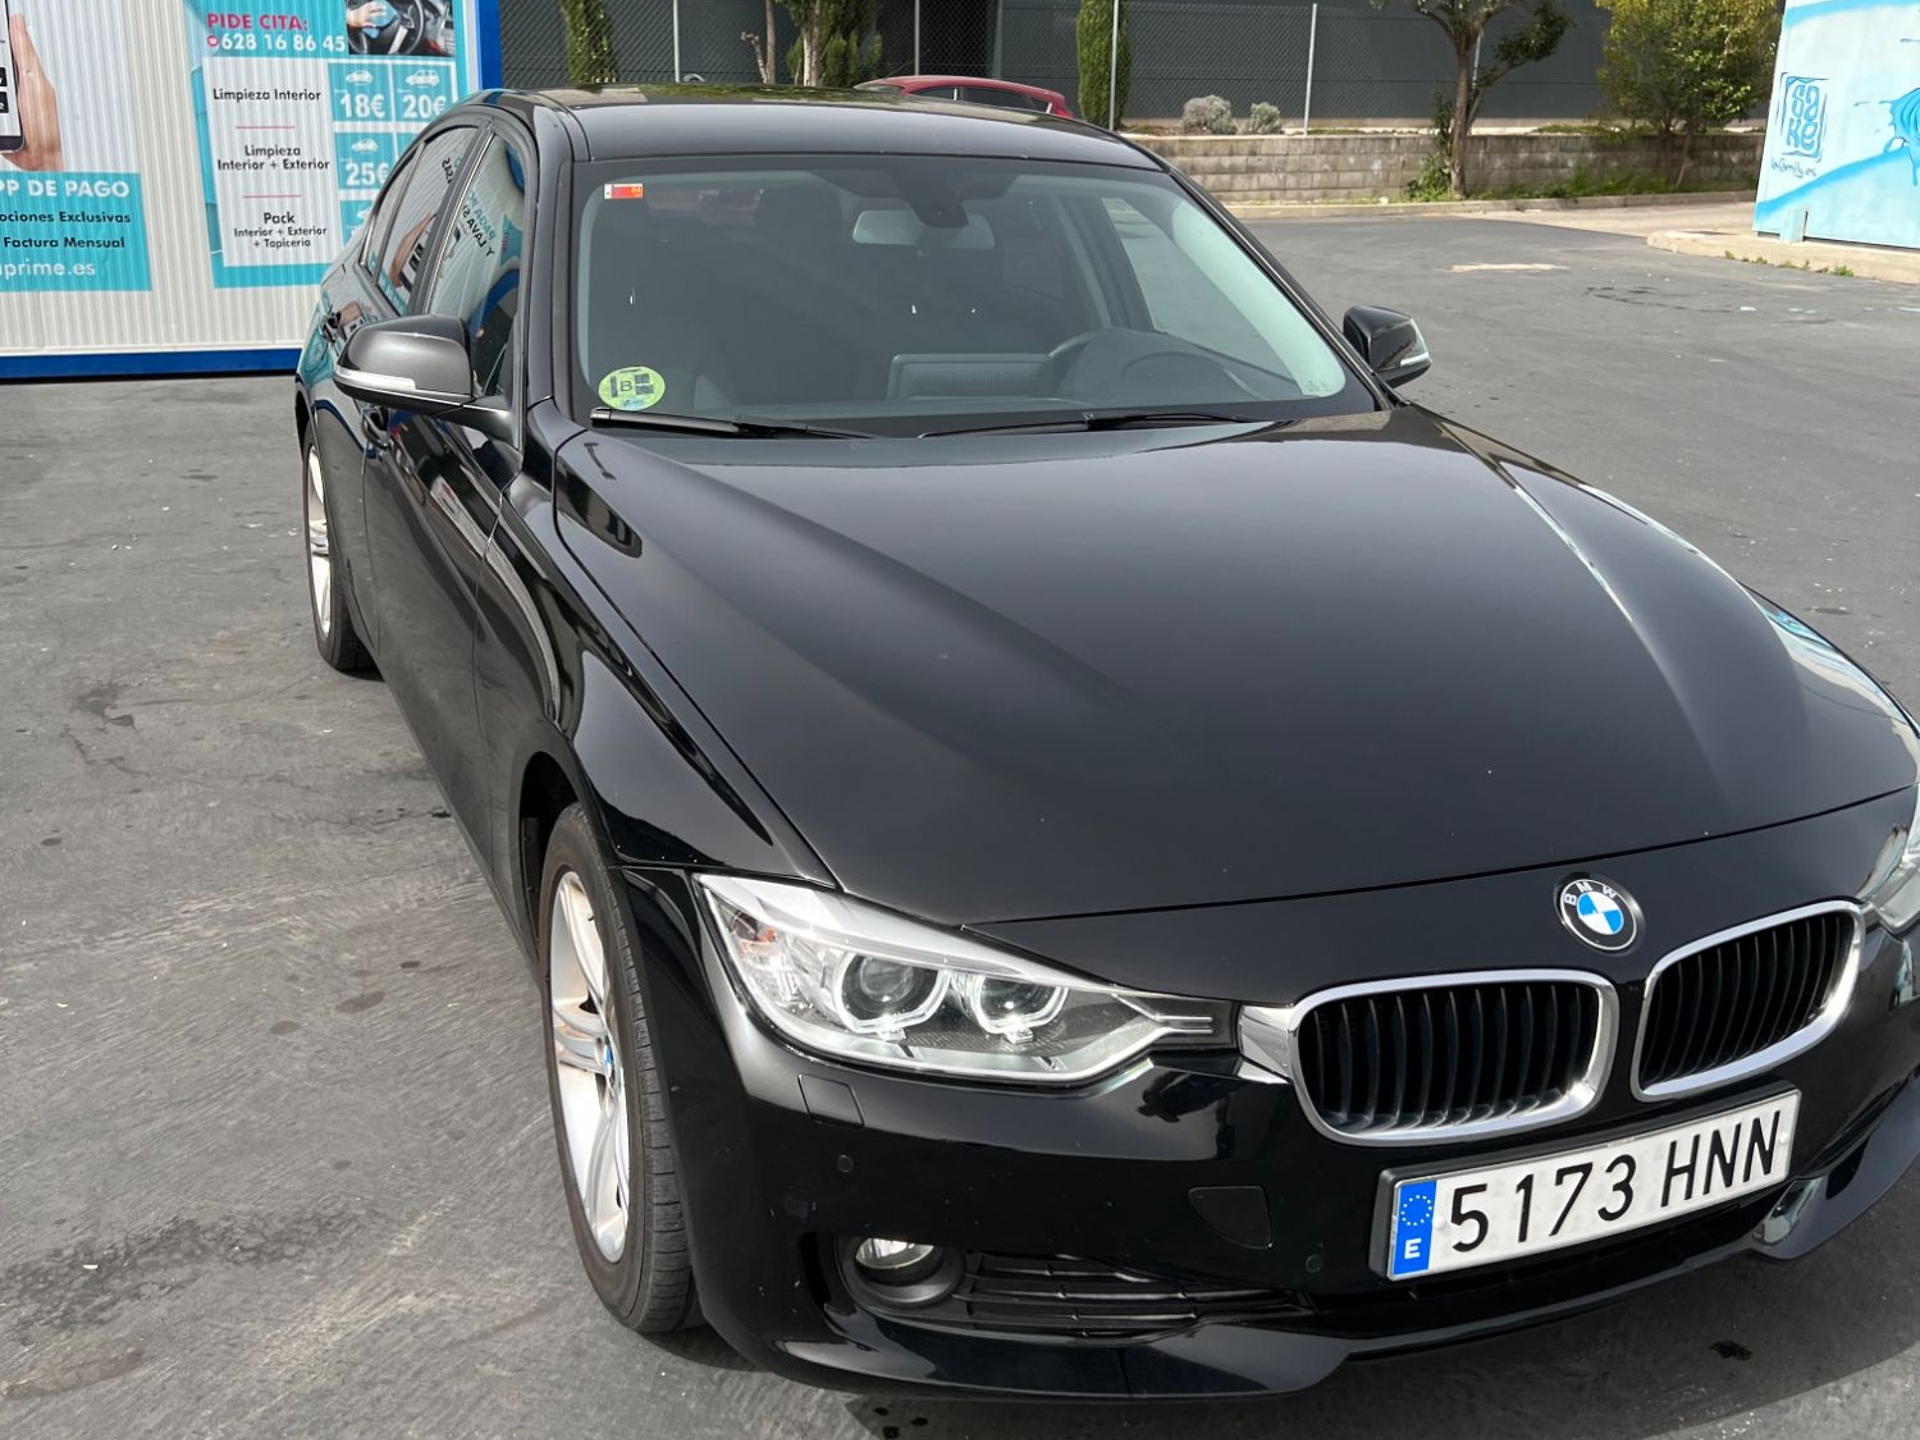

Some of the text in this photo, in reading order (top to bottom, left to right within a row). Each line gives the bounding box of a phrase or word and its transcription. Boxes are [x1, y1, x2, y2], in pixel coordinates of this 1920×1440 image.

[207, 13, 308, 31] PIDE CITA:
[222, 33, 346, 52] 628 16 86 45
[213, 88, 322, 103] Limpieza Interior
[340, 93, 386, 119] 18€
[402, 94, 446, 118] 20€
[244, 144, 301, 158] Limpieza
[217, 159, 265, 170] Interior
[270, 161, 278, 169] +
[282, 158, 330, 169] Exterior
[345, 161, 389, 186] 25€
[28, 180, 57, 197] DE
[65, 181, 129, 198] PAGO
[59, 211, 131, 223] Exclusivas
[263, 211, 295, 224] Pack
[234, 227, 273, 237] Interior
[287, 226, 327, 236] Exterior
[4, 237, 125, 249] Factura Mensual
[0, 258, 96, 280] prime.es
[620, 381, 632, 391] B
[1563, 881, 1618, 906] BMW
[1451, 1110, 1781, 1252] 5173 HNN
[1404, 1238, 1422, 1259] E
